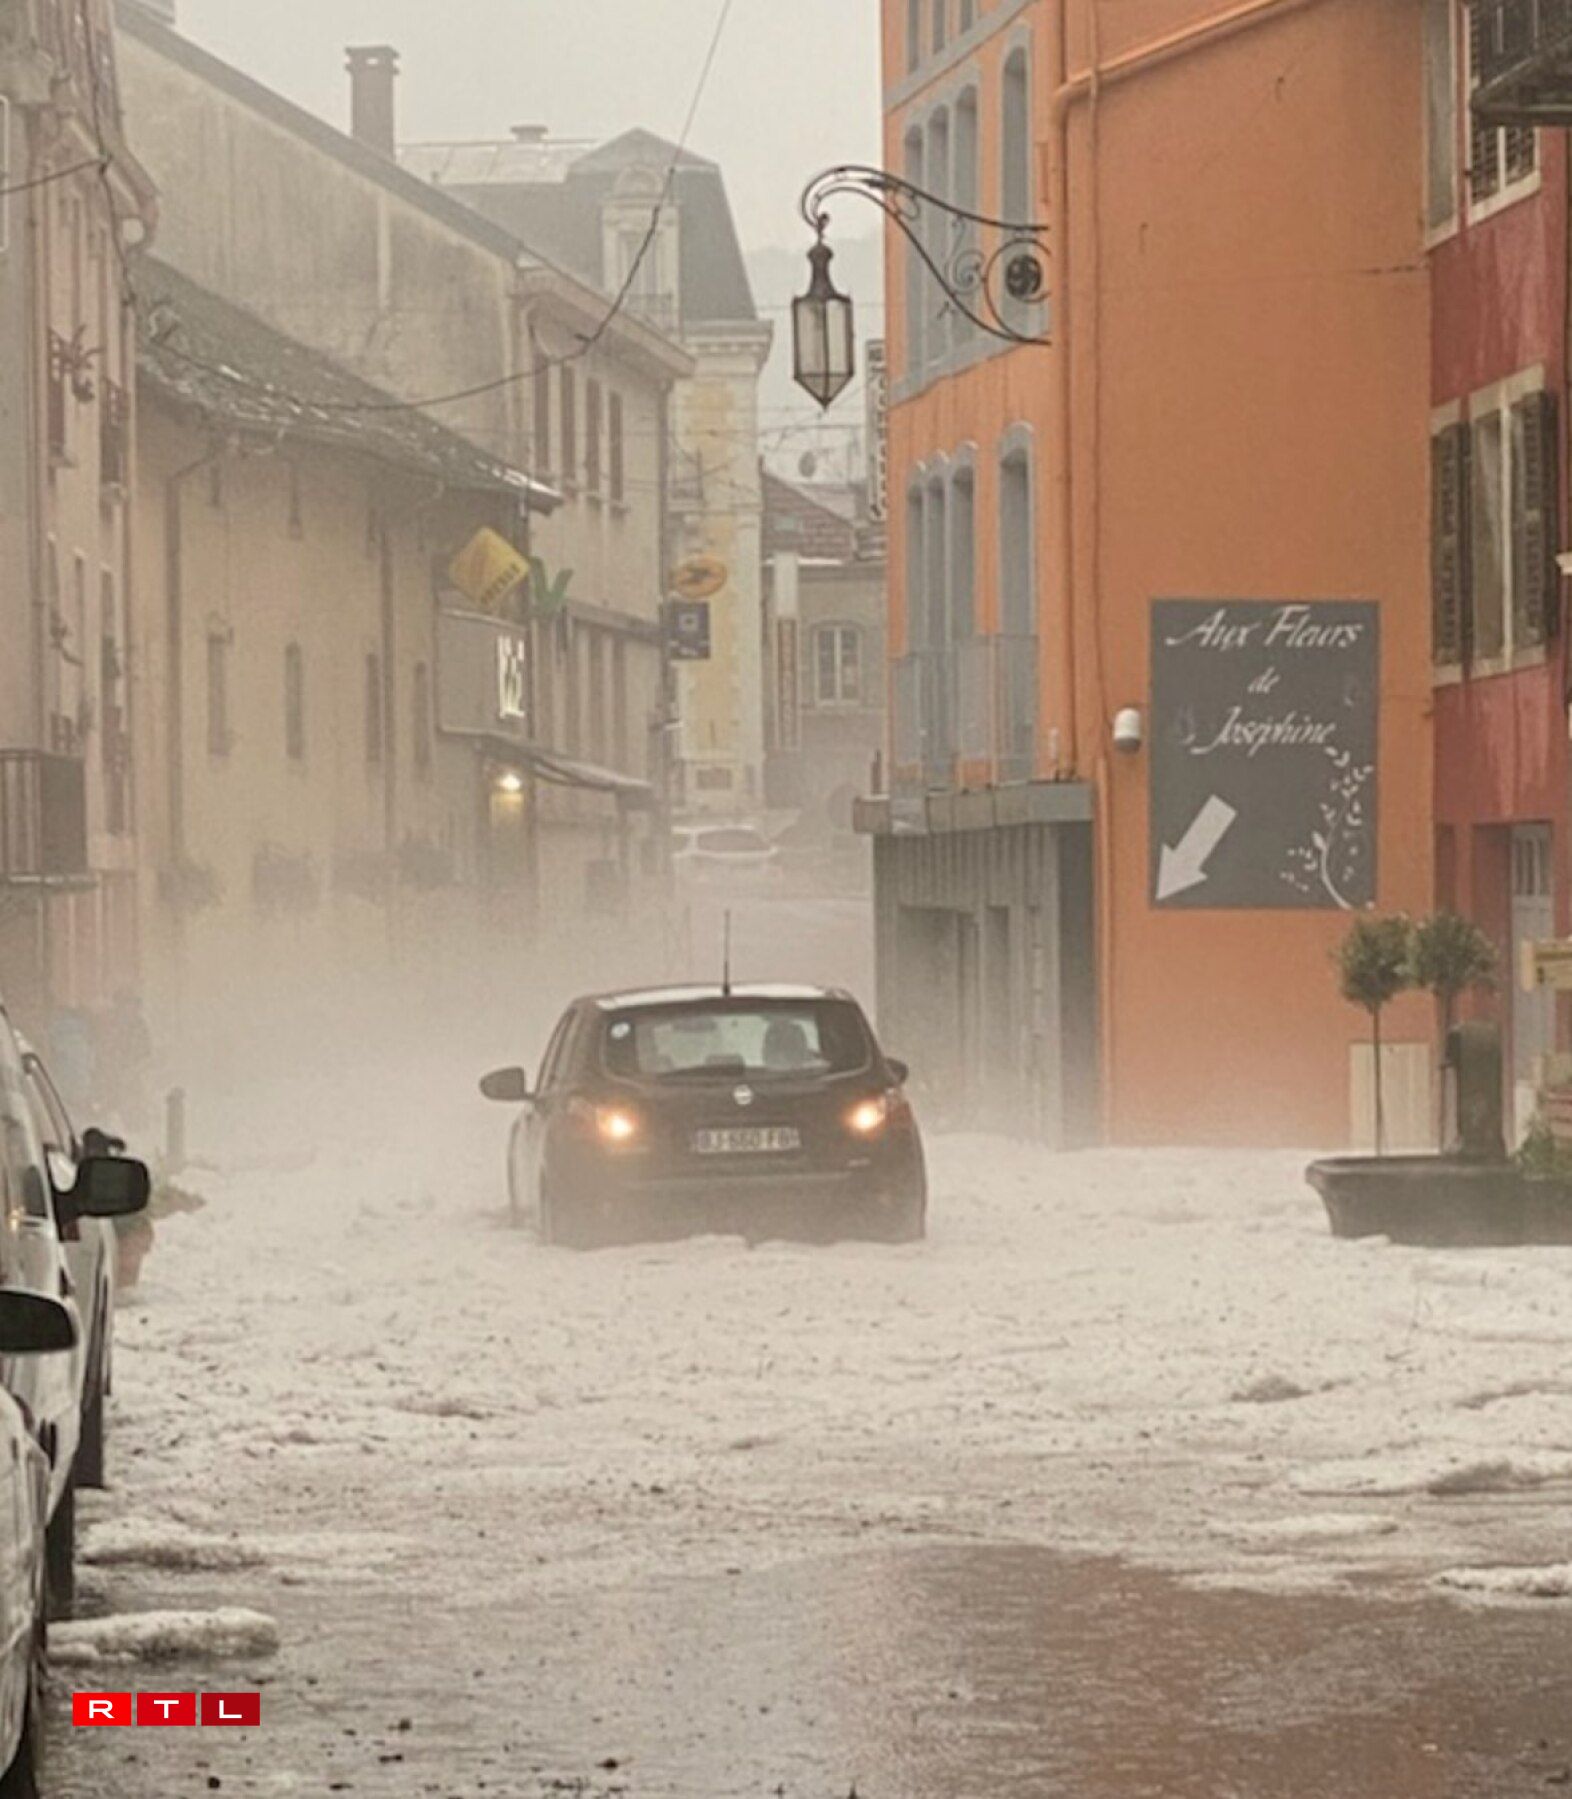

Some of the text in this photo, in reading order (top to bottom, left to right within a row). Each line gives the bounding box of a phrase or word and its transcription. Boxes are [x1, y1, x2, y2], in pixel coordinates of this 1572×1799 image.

[1165, 605, 1363, 650] Aux Fleurs
[1248, 667, 1280, 693] de
